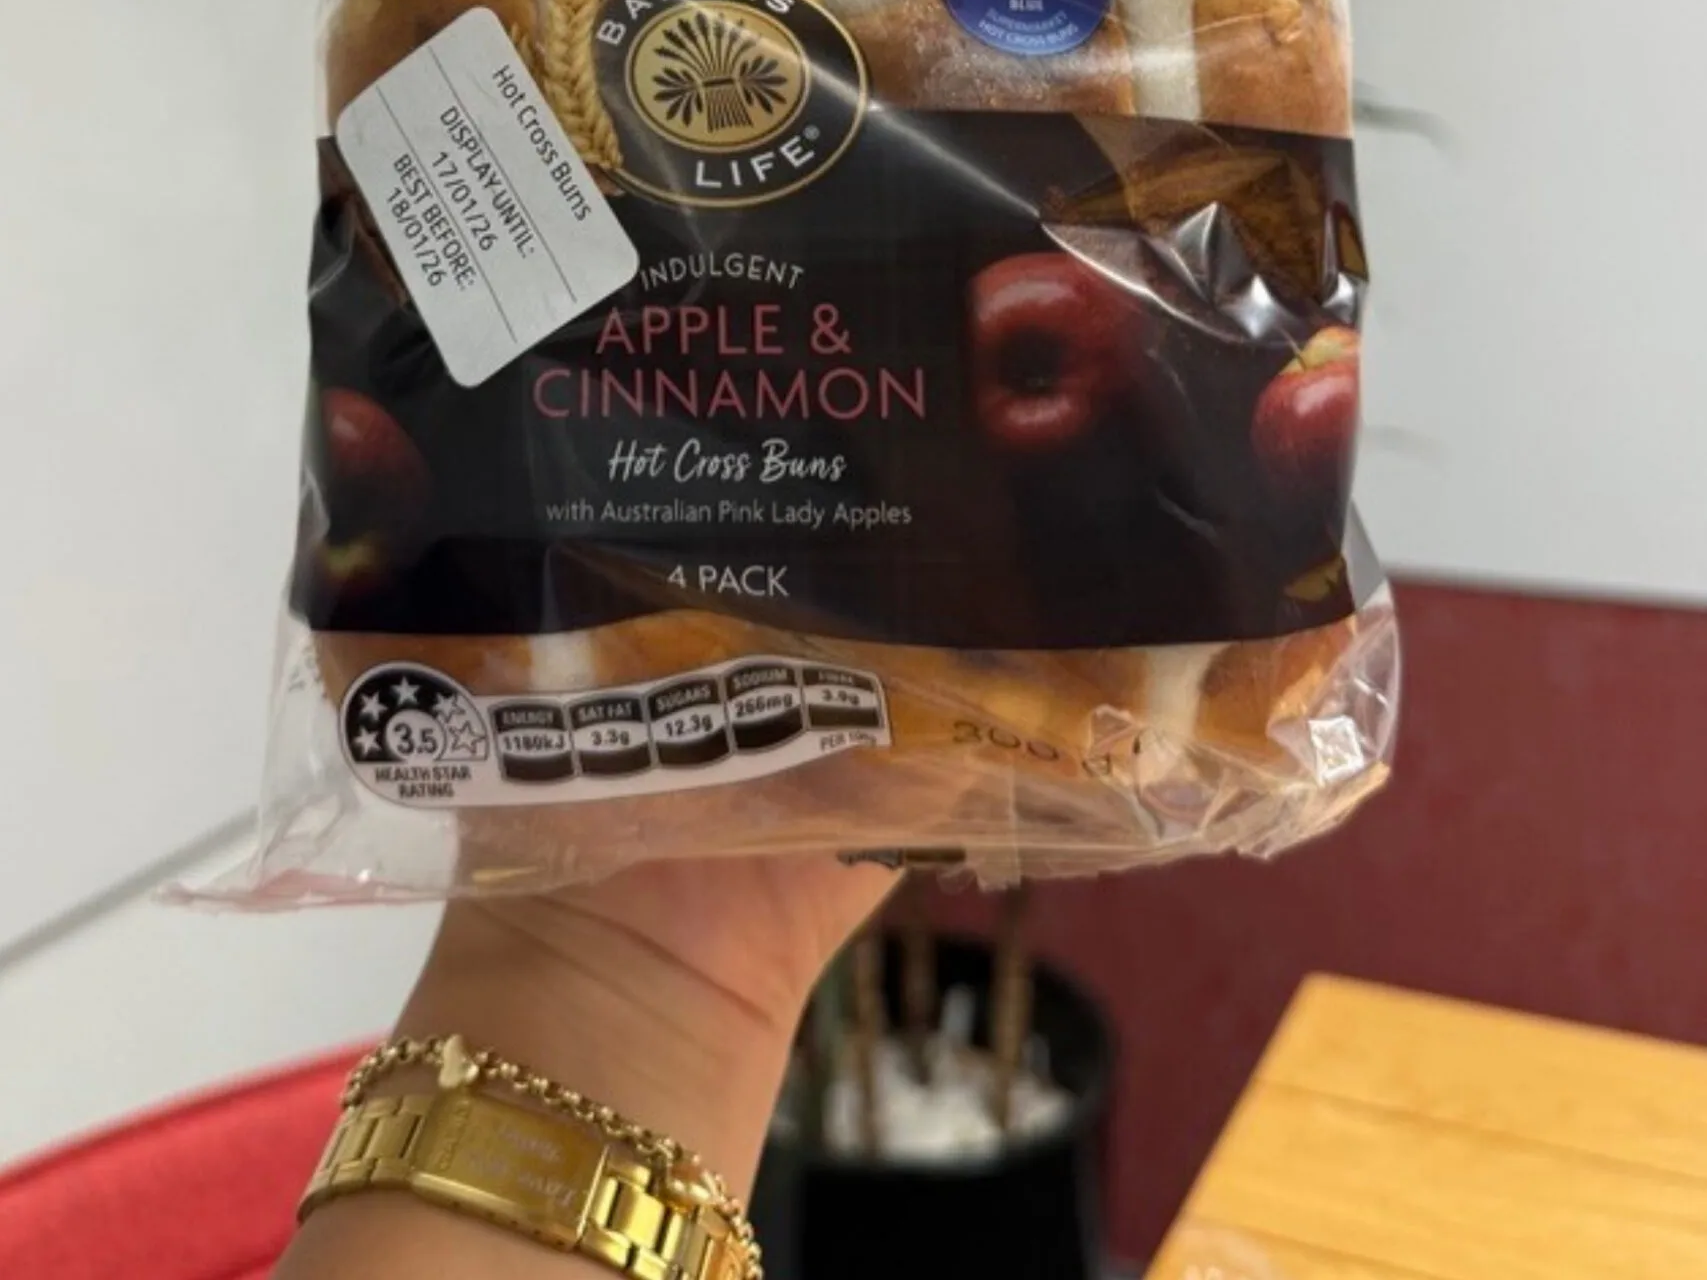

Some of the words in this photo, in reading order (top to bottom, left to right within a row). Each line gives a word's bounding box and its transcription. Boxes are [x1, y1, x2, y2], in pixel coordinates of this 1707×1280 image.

[978, 19, 1005, 39] HOT
[1006, 32, 1046, 47] CROSS
[492, 64, 526, 108] Hot
[517, 104, 559, 165] Cross
[550, 160, 593, 222] Buns
[439, 105, 502, 191] DISPLAY
[491, 189, 535, 258] UNTIL:
[431, 151, 499, 251] 17/01/26
[386, 187, 447, 287] 18/01/26
[393, 153, 434, 205] BEST
[421, 203, 477, 290] BEFORE:
[639, 251, 806, 291] INDULGENT
[595, 303, 785, 356] APPLE
[809, 302, 852, 356] &
[532, 366, 927, 420] CINNAMON
[607, 439, 668, 482] Hot
[673, 437, 752, 483] Cross
[759, 438, 848, 483] Buns
[546, 499, 595, 523] with
[600, 499, 712, 524] Australian
[717, 499, 764, 524] Pink
[772, 499, 826, 531] Lady
[833, 501, 912, 532] Apples
[667, 564, 688, 590] 4
[698, 564, 790, 598] PACK
[731, 667, 788, 690] SODIUM
[655, 684, 712, 710] SUGARS
[734, 693, 793, 718] 266mg
[393, 722, 438, 755] 3.5
[590, 727, 631, 747] 3.3g
[664, 713, 713, 737] 12.3g
[375, 766, 431, 782] HEALTH
[431, 765, 471, 782] STAR
[398, 782, 455, 798] RATING
